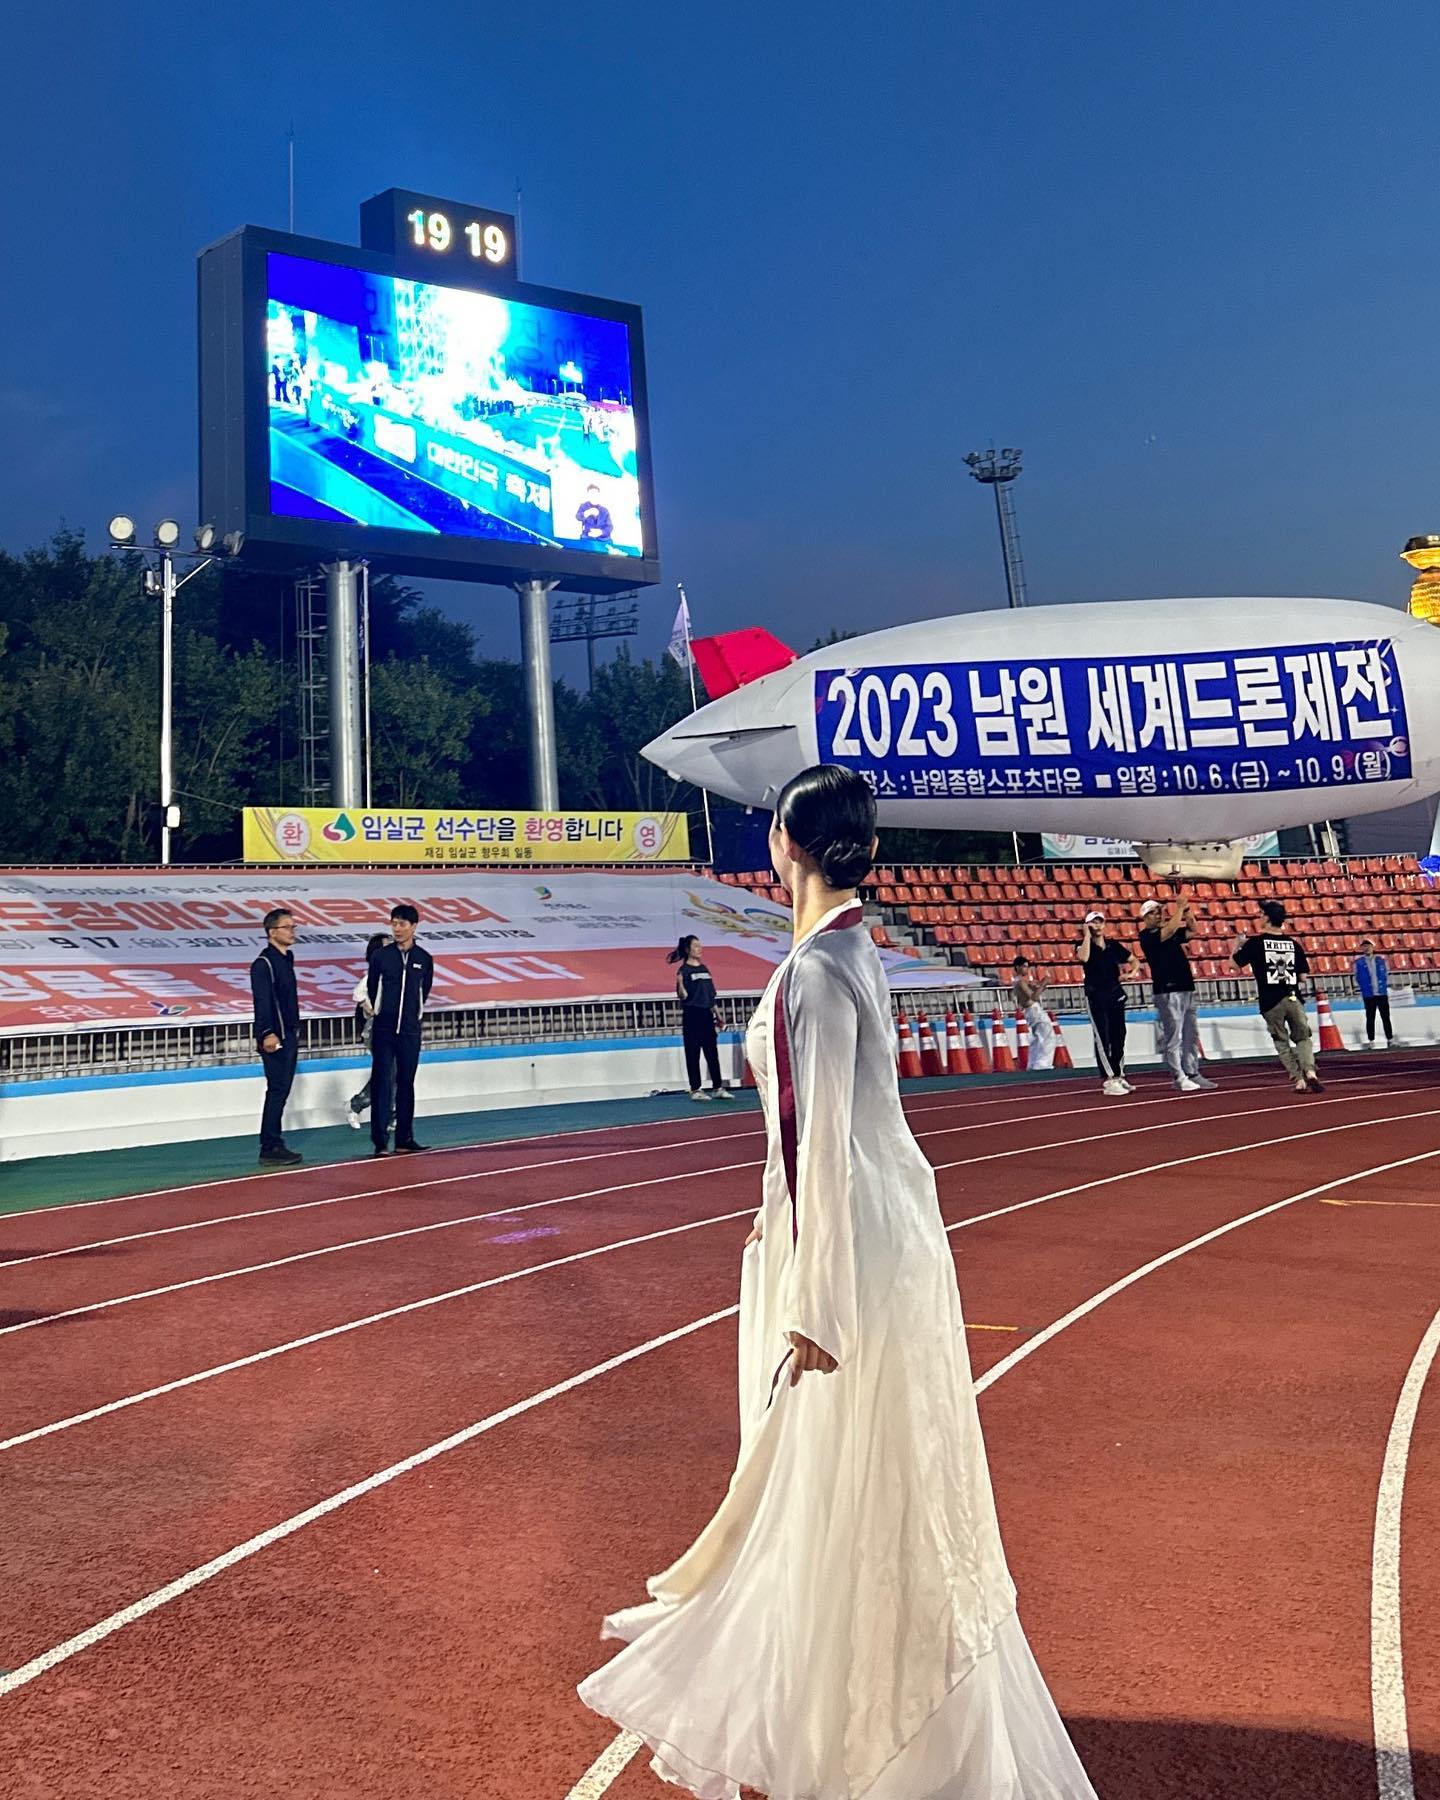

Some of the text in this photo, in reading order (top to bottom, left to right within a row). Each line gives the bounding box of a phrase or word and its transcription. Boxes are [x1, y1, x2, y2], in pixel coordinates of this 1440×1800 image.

[408, 210, 506, 263] 19 19
[827, 647, 1394, 758] 2023 남원 세계드론제전
[910, 766, 1083, 796] 남원종합스포츠타운
[361, 815, 623, 842] 임실군 선수단을 환영합니다
[640, 825, 656, 848] 영
[448, 847, 477, 859] 임실군
[1264, 941, 1295, 951] WHITE
